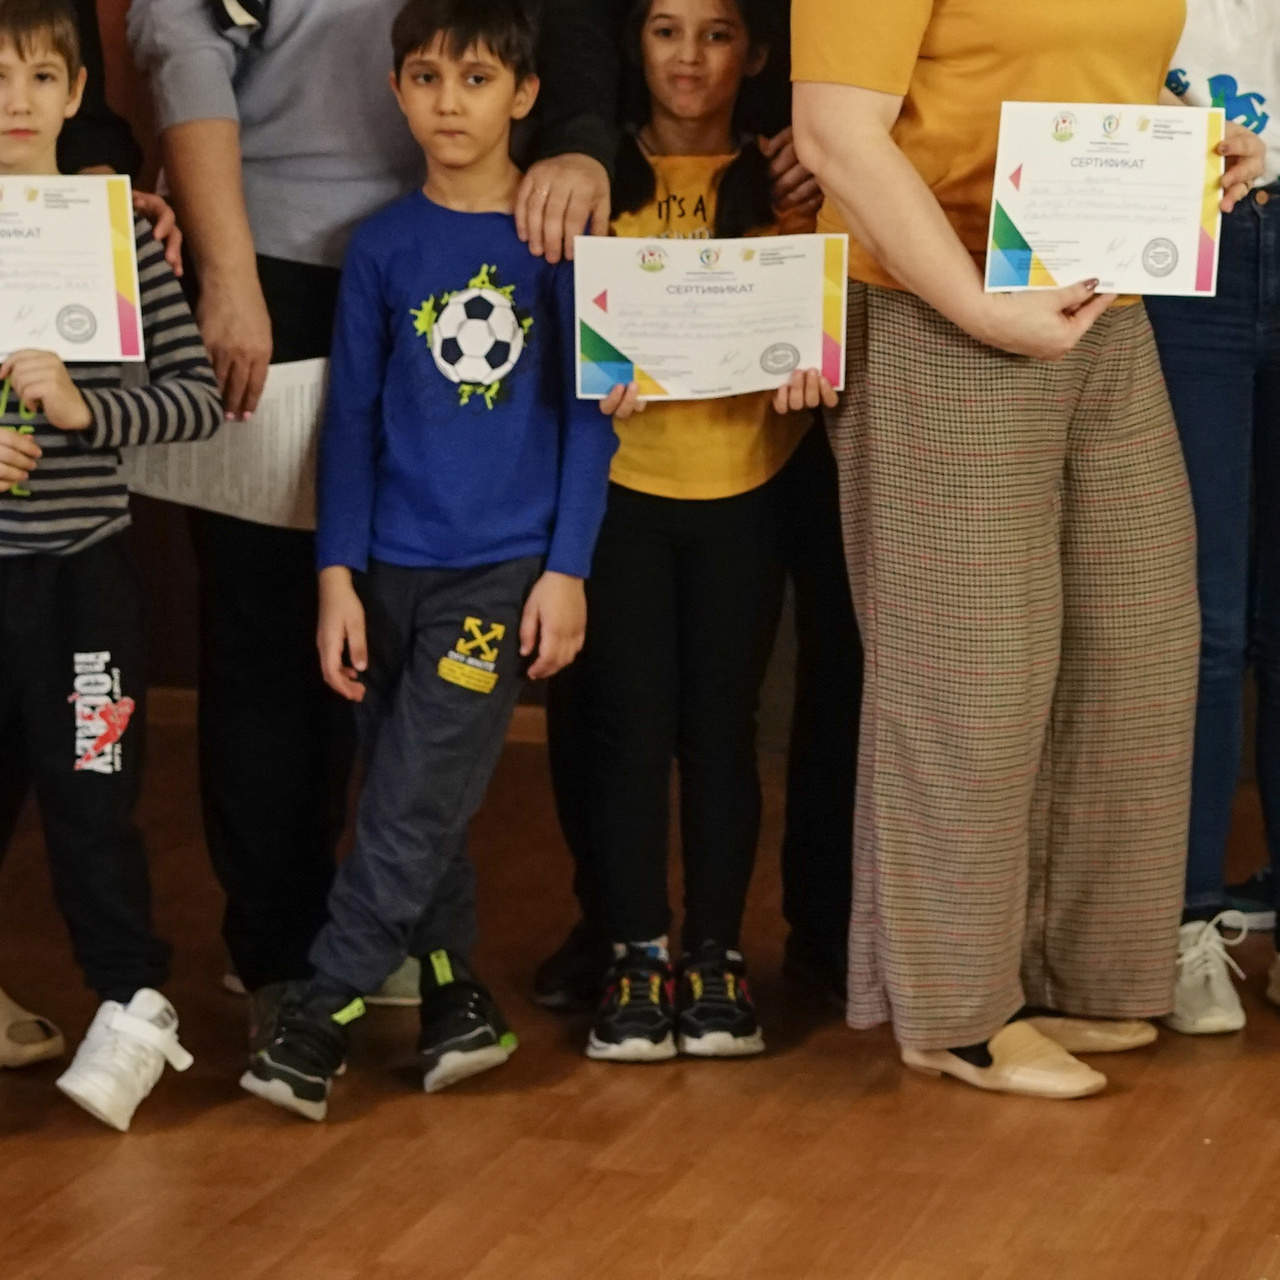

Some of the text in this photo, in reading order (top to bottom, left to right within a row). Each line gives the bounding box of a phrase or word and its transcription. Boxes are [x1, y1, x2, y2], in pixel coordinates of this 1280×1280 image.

[1070, 157, 1146, 169] СЕРТИФИКАТ
[658, 194, 707, 222] IT'S A
[666, 283, 755, 296] СЕРТИФИКАТ
